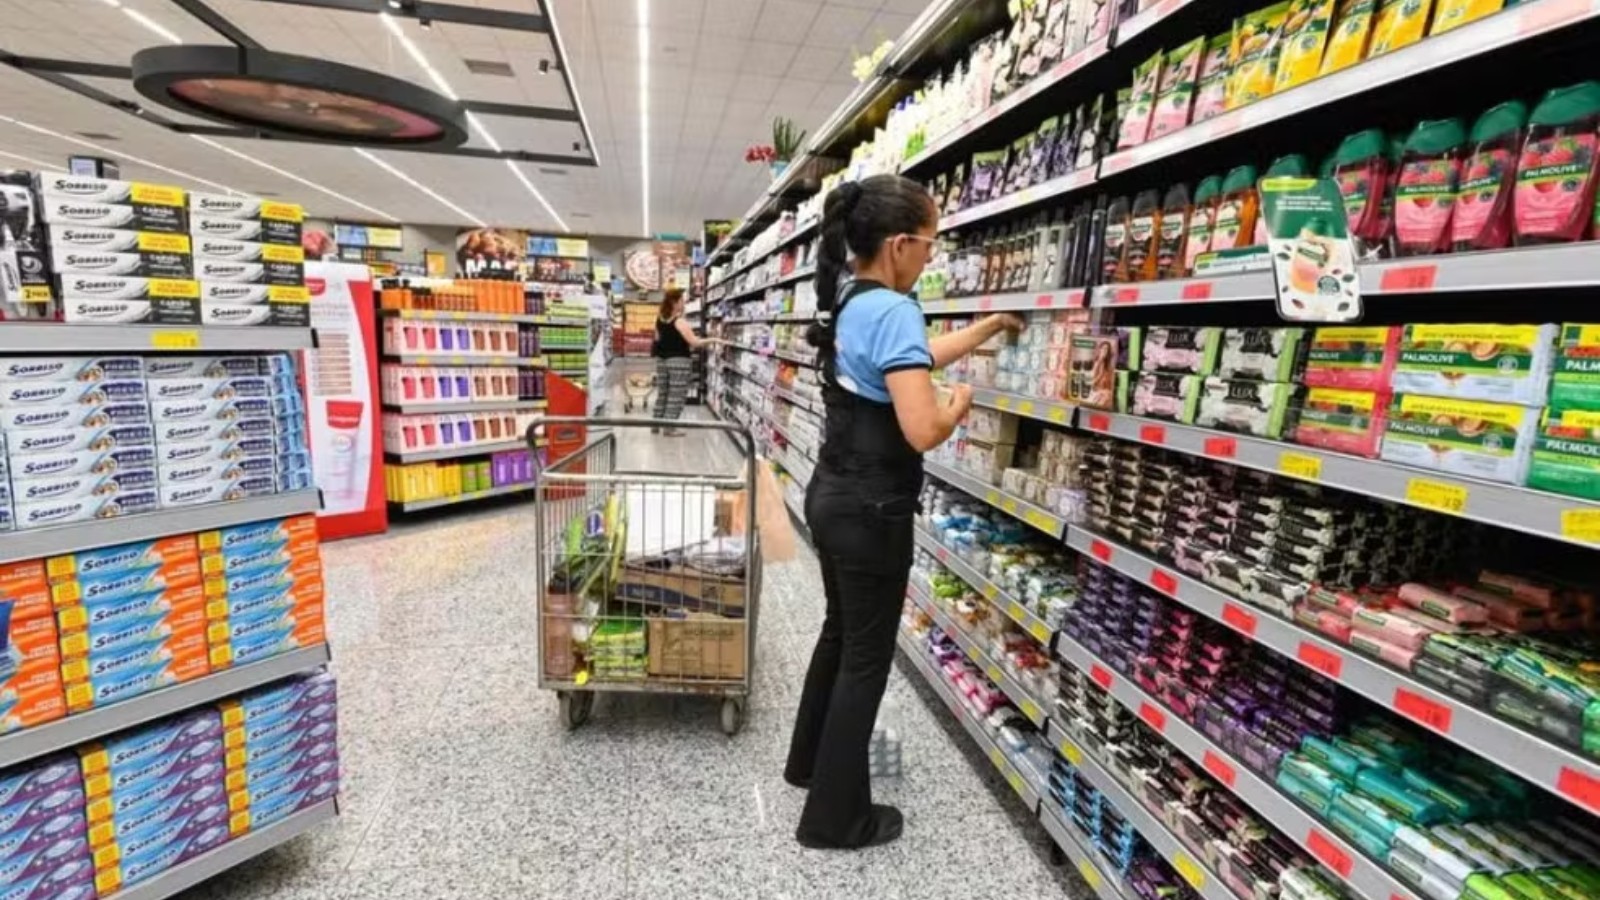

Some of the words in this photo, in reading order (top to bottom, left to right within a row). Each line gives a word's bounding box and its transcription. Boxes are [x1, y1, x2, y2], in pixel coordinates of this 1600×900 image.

[1525, 165, 1577, 178] PALMOLIVE
[1402, 354, 1454, 363] PALMOLIVE
[1390, 422, 1440, 436] PALMOLIVE
